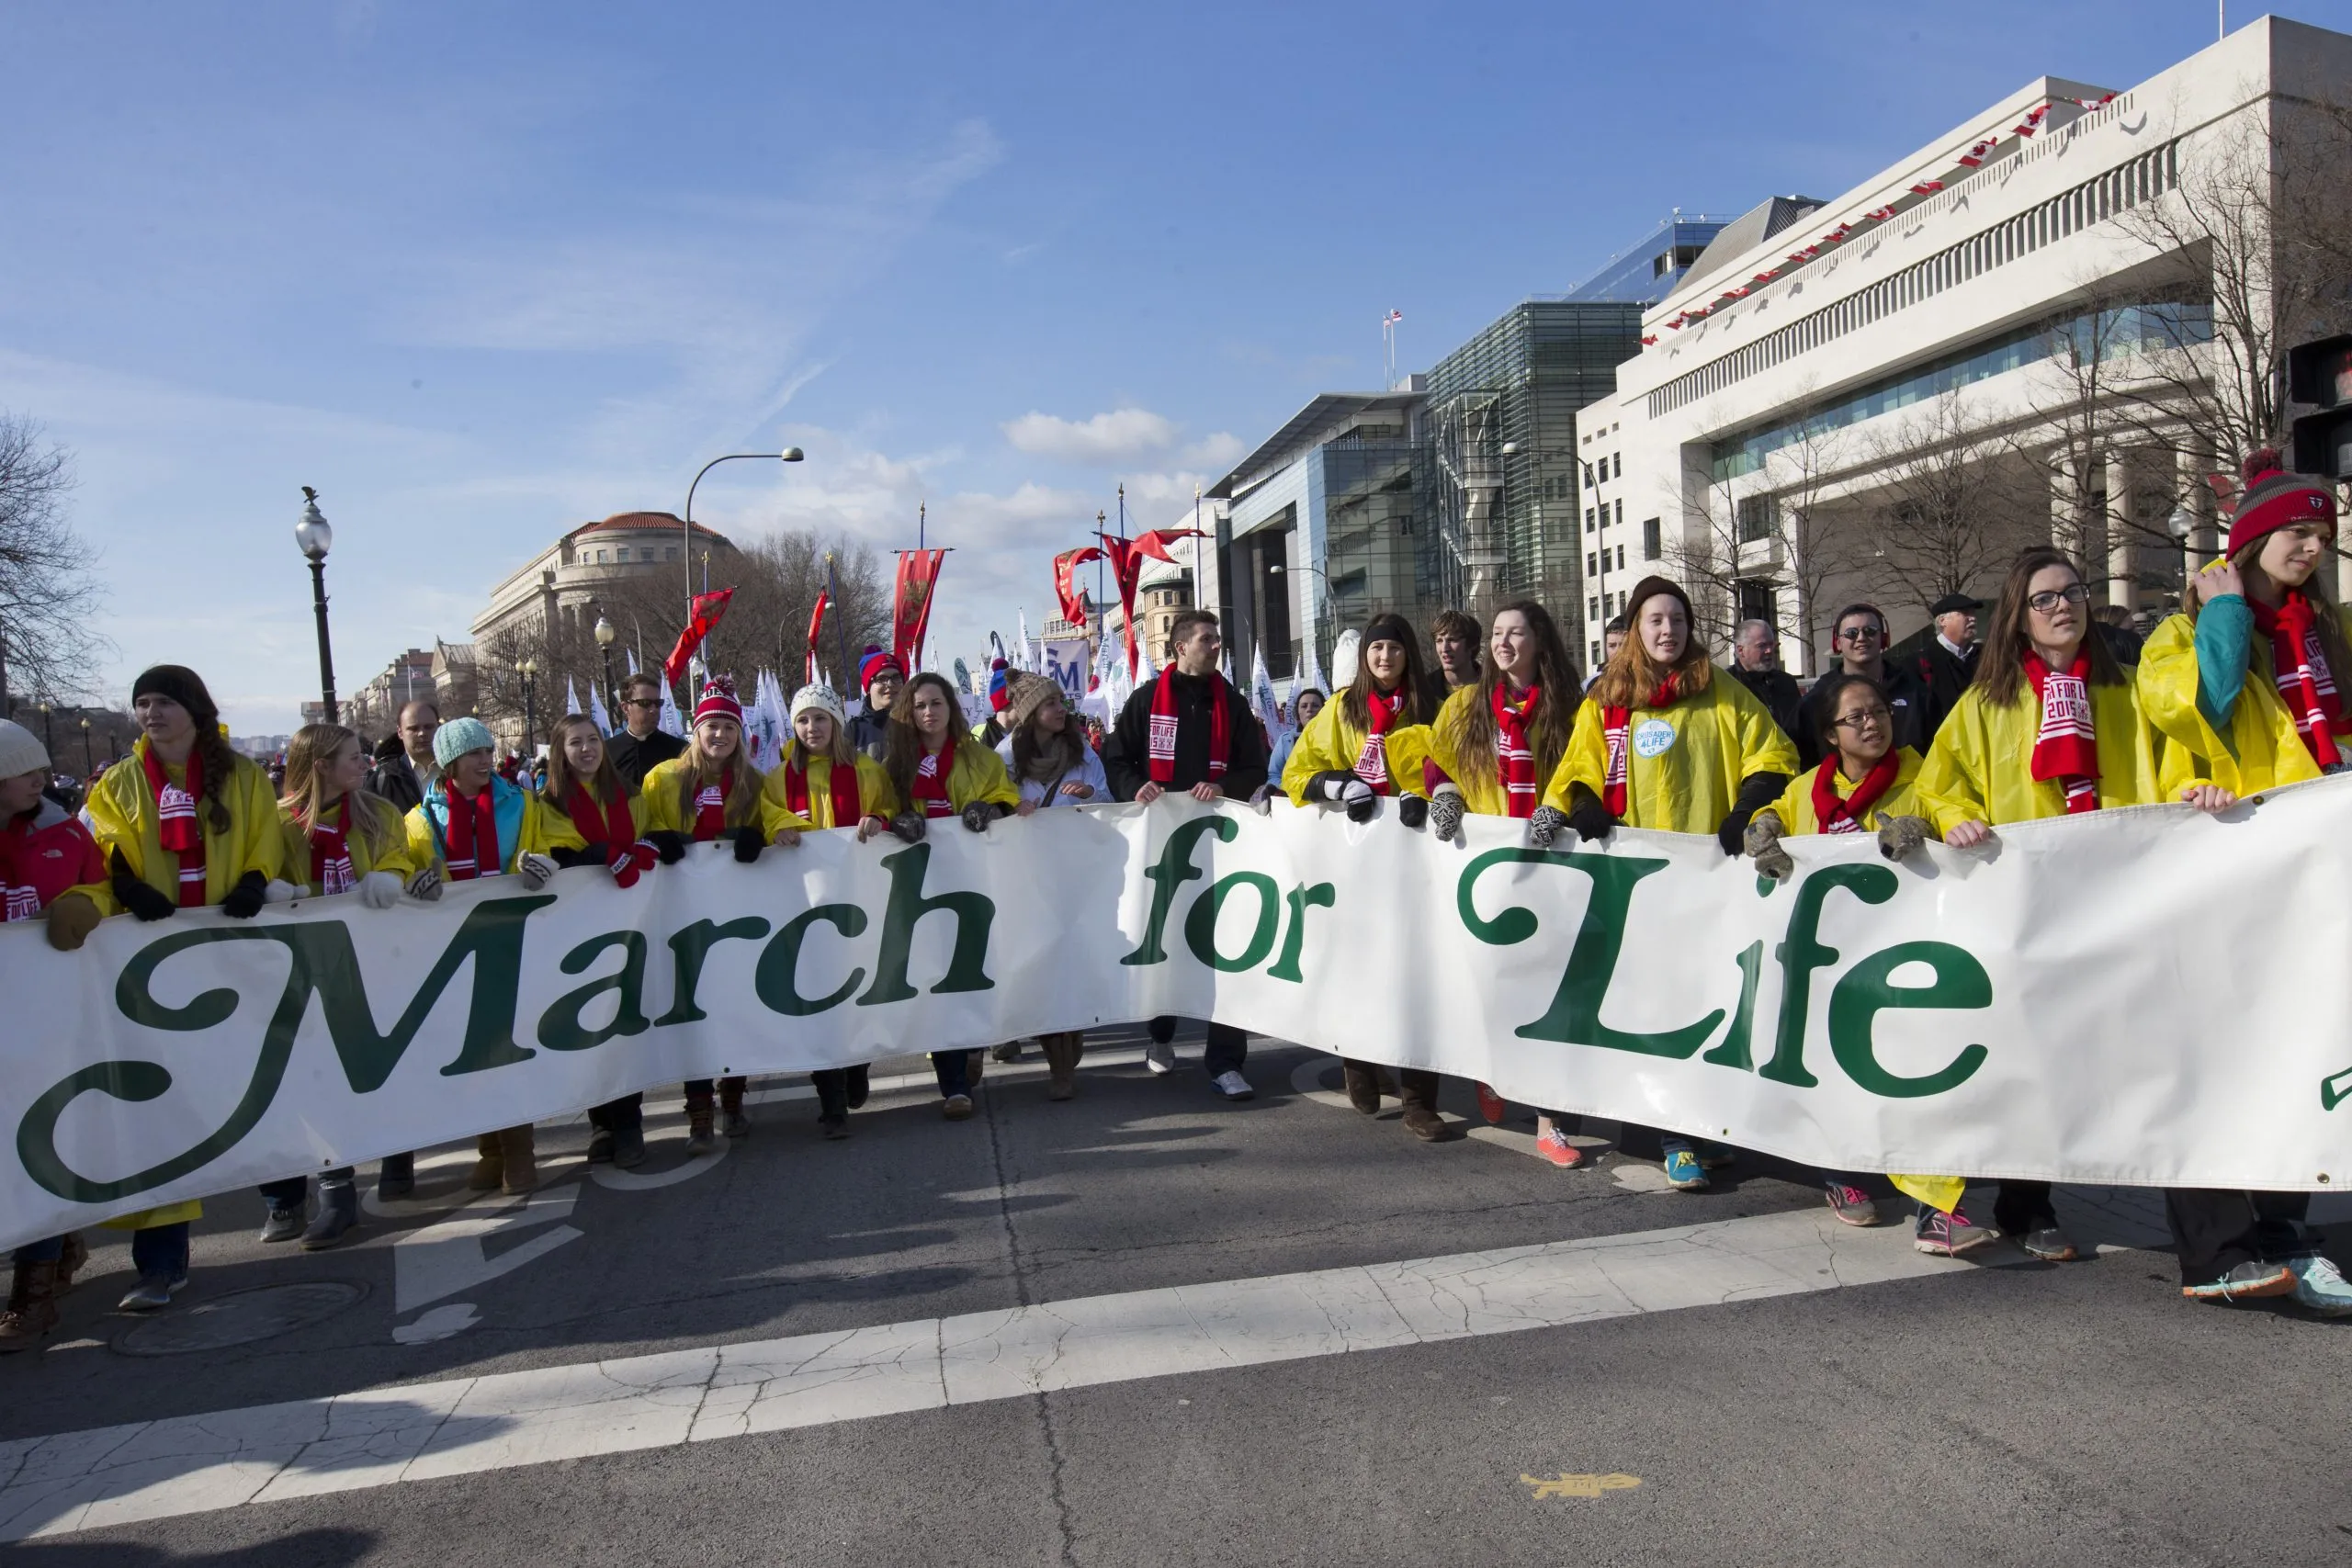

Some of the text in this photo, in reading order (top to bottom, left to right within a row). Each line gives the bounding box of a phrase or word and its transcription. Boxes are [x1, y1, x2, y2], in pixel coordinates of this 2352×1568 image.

[2056, 682, 2076, 698] FOR
[2047, 701, 2076, 718] 2015
[1161, 726, 1175, 738] LIFE
[17, 815, 1993, 1203] March for Life
